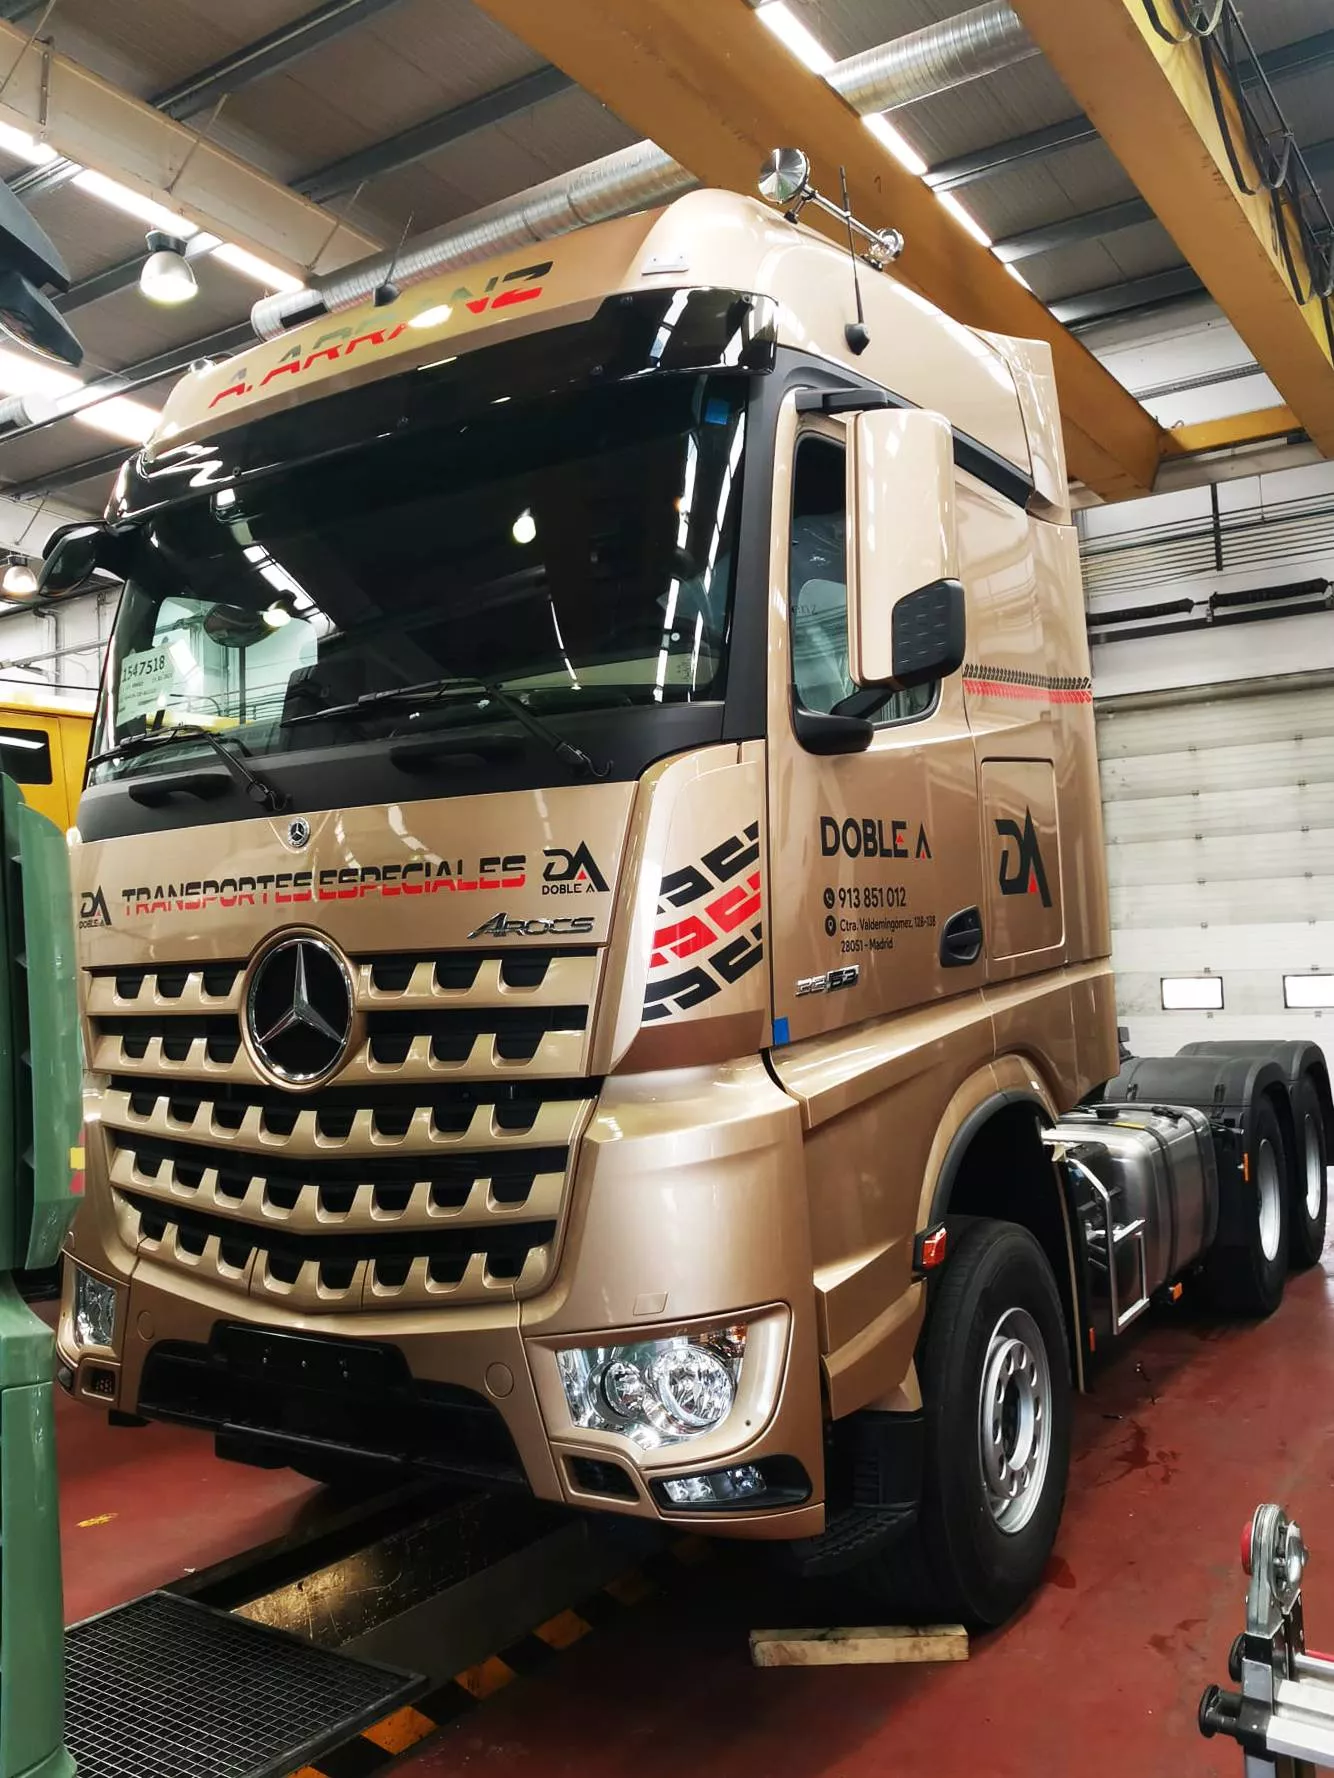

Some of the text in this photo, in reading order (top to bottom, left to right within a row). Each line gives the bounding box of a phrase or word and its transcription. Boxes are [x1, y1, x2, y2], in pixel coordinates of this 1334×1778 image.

[122, 655, 165, 682] 1547518
[820, 816, 908, 858] DOBLE
[122, 855, 526, 916] TRANSPORTES ESPECIALES
[542, 883, 582, 895] DOBLE
[838, 887, 907, 909] 913 851 012
[840, 919, 858, 932] Ctra.
[841, 939, 863, 952] 28051
[869, 937, 893, 951] Madrid
